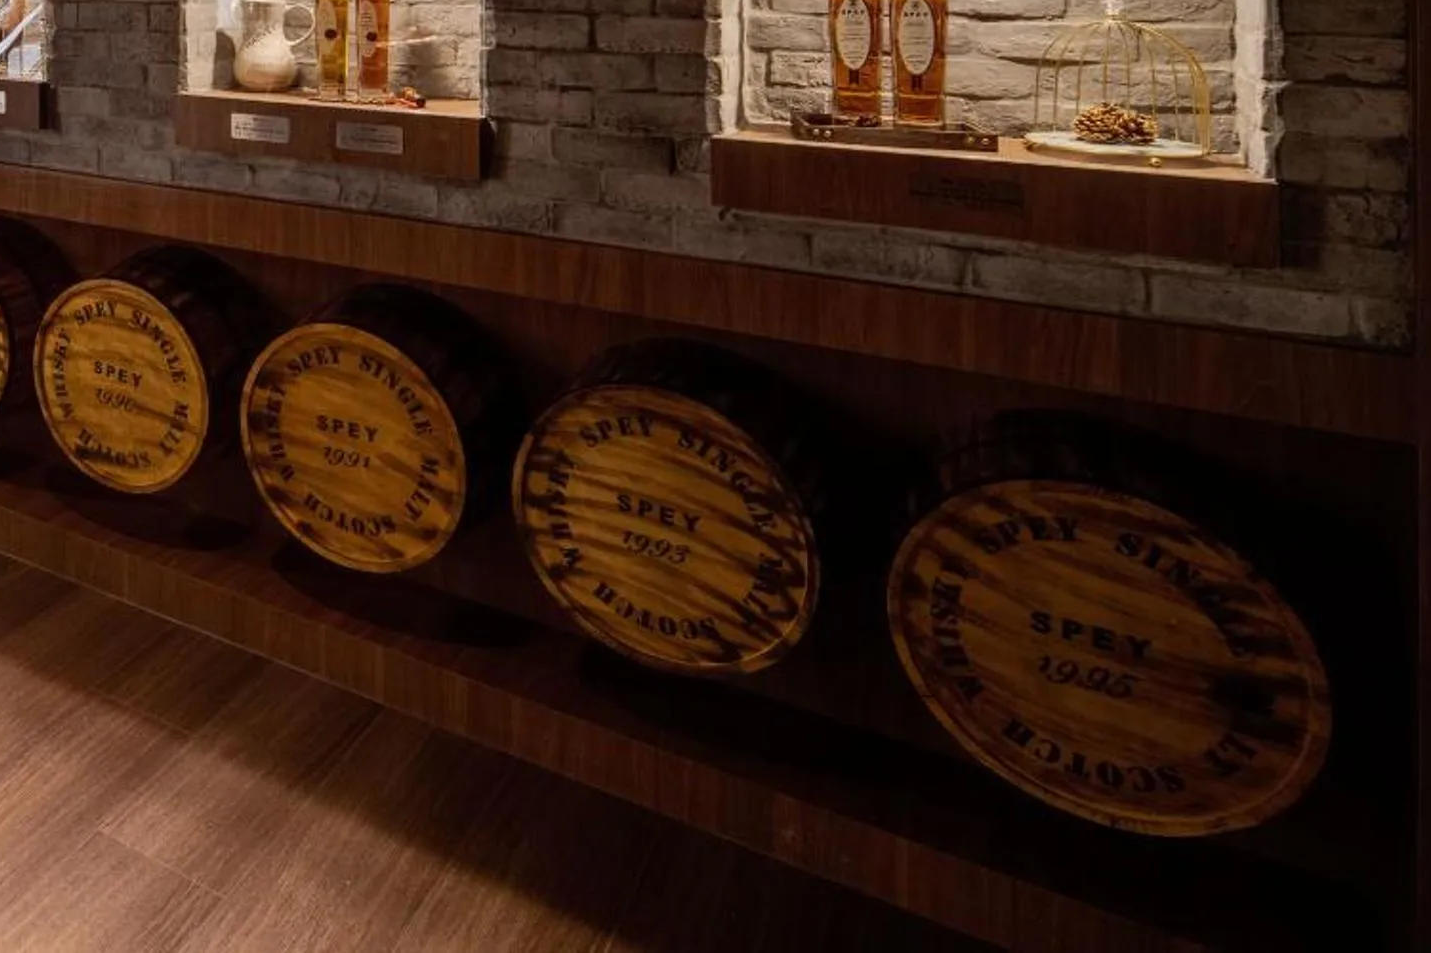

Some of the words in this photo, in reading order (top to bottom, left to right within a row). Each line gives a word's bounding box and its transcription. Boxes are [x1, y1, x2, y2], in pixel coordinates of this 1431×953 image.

[93, 360, 143, 388] SPEY
[287, 346, 342, 378] SPEY
[316, 414, 380, 443] SPEY
[323, 446, 371, 469] 1991
[618, 494, 701, 533] SPEY
[1030, 610, 1152, 660] SPEY
[1002, 717, 1185, 793] SCOTCH
